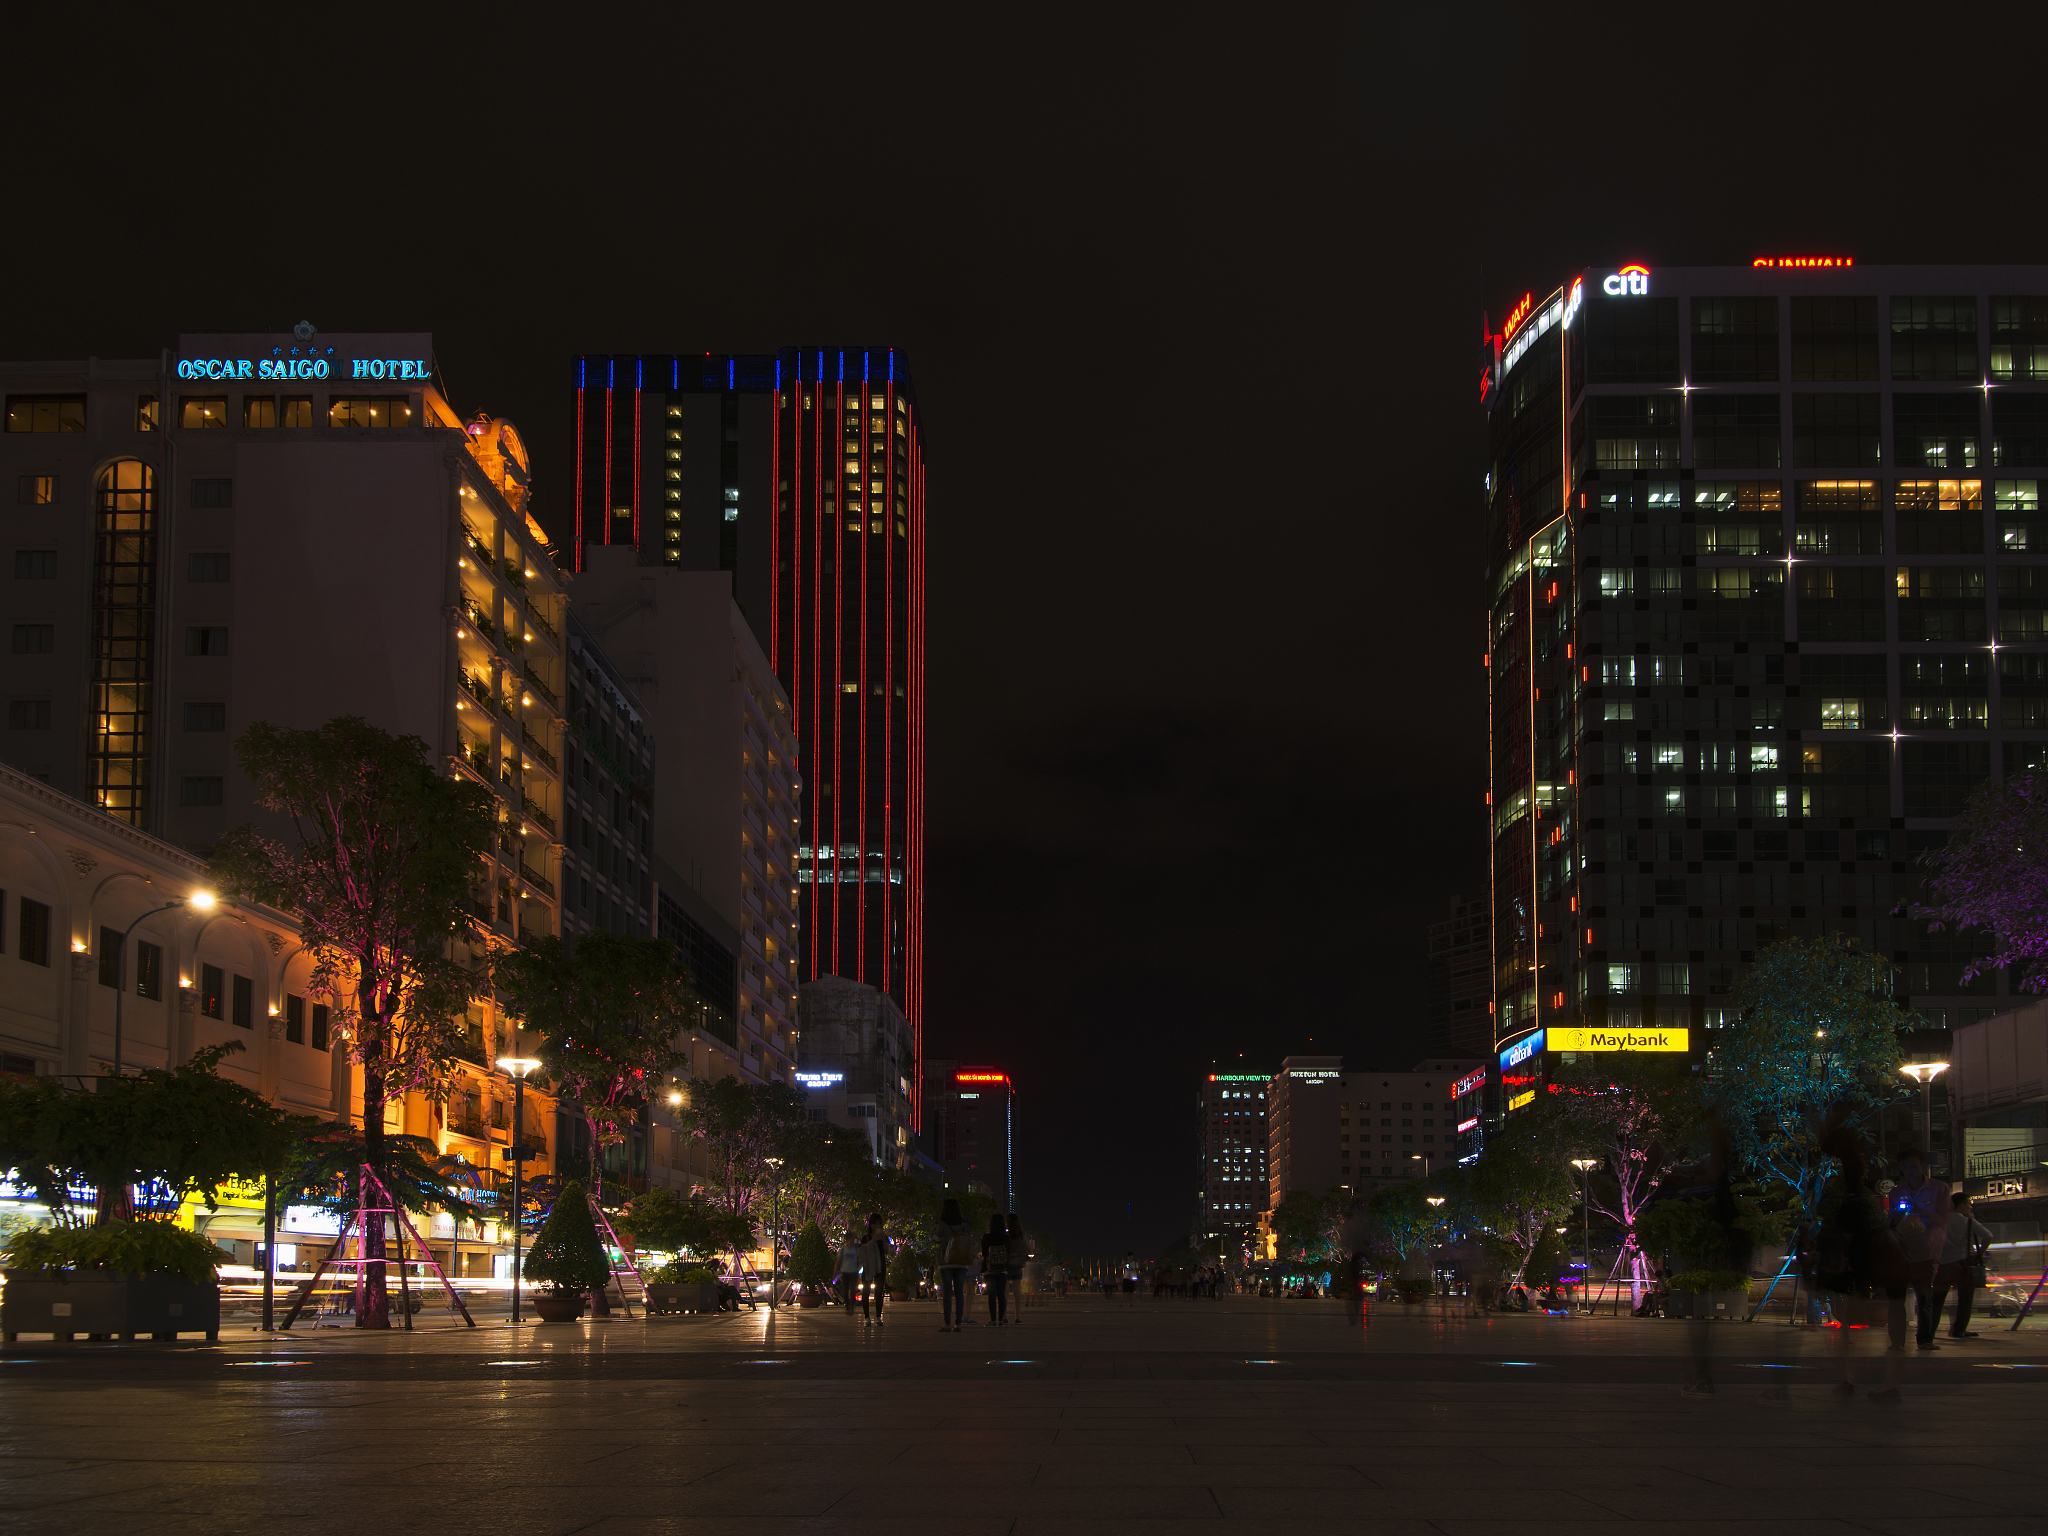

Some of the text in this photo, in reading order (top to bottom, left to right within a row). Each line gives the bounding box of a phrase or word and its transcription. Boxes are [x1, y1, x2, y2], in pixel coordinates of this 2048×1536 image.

[1604, 266, 1649, 295] citi
[1504, 291, 1531, 340] WAH
[177, 358, 253, 380] OSCAR
[352, 358, 431, 380] HOTEL
[1590, 1033, 1669, 1050] Maybank
[230, 1177, 266, 1192] Express
[1987, 1177, 2024, 1197] EDEN
